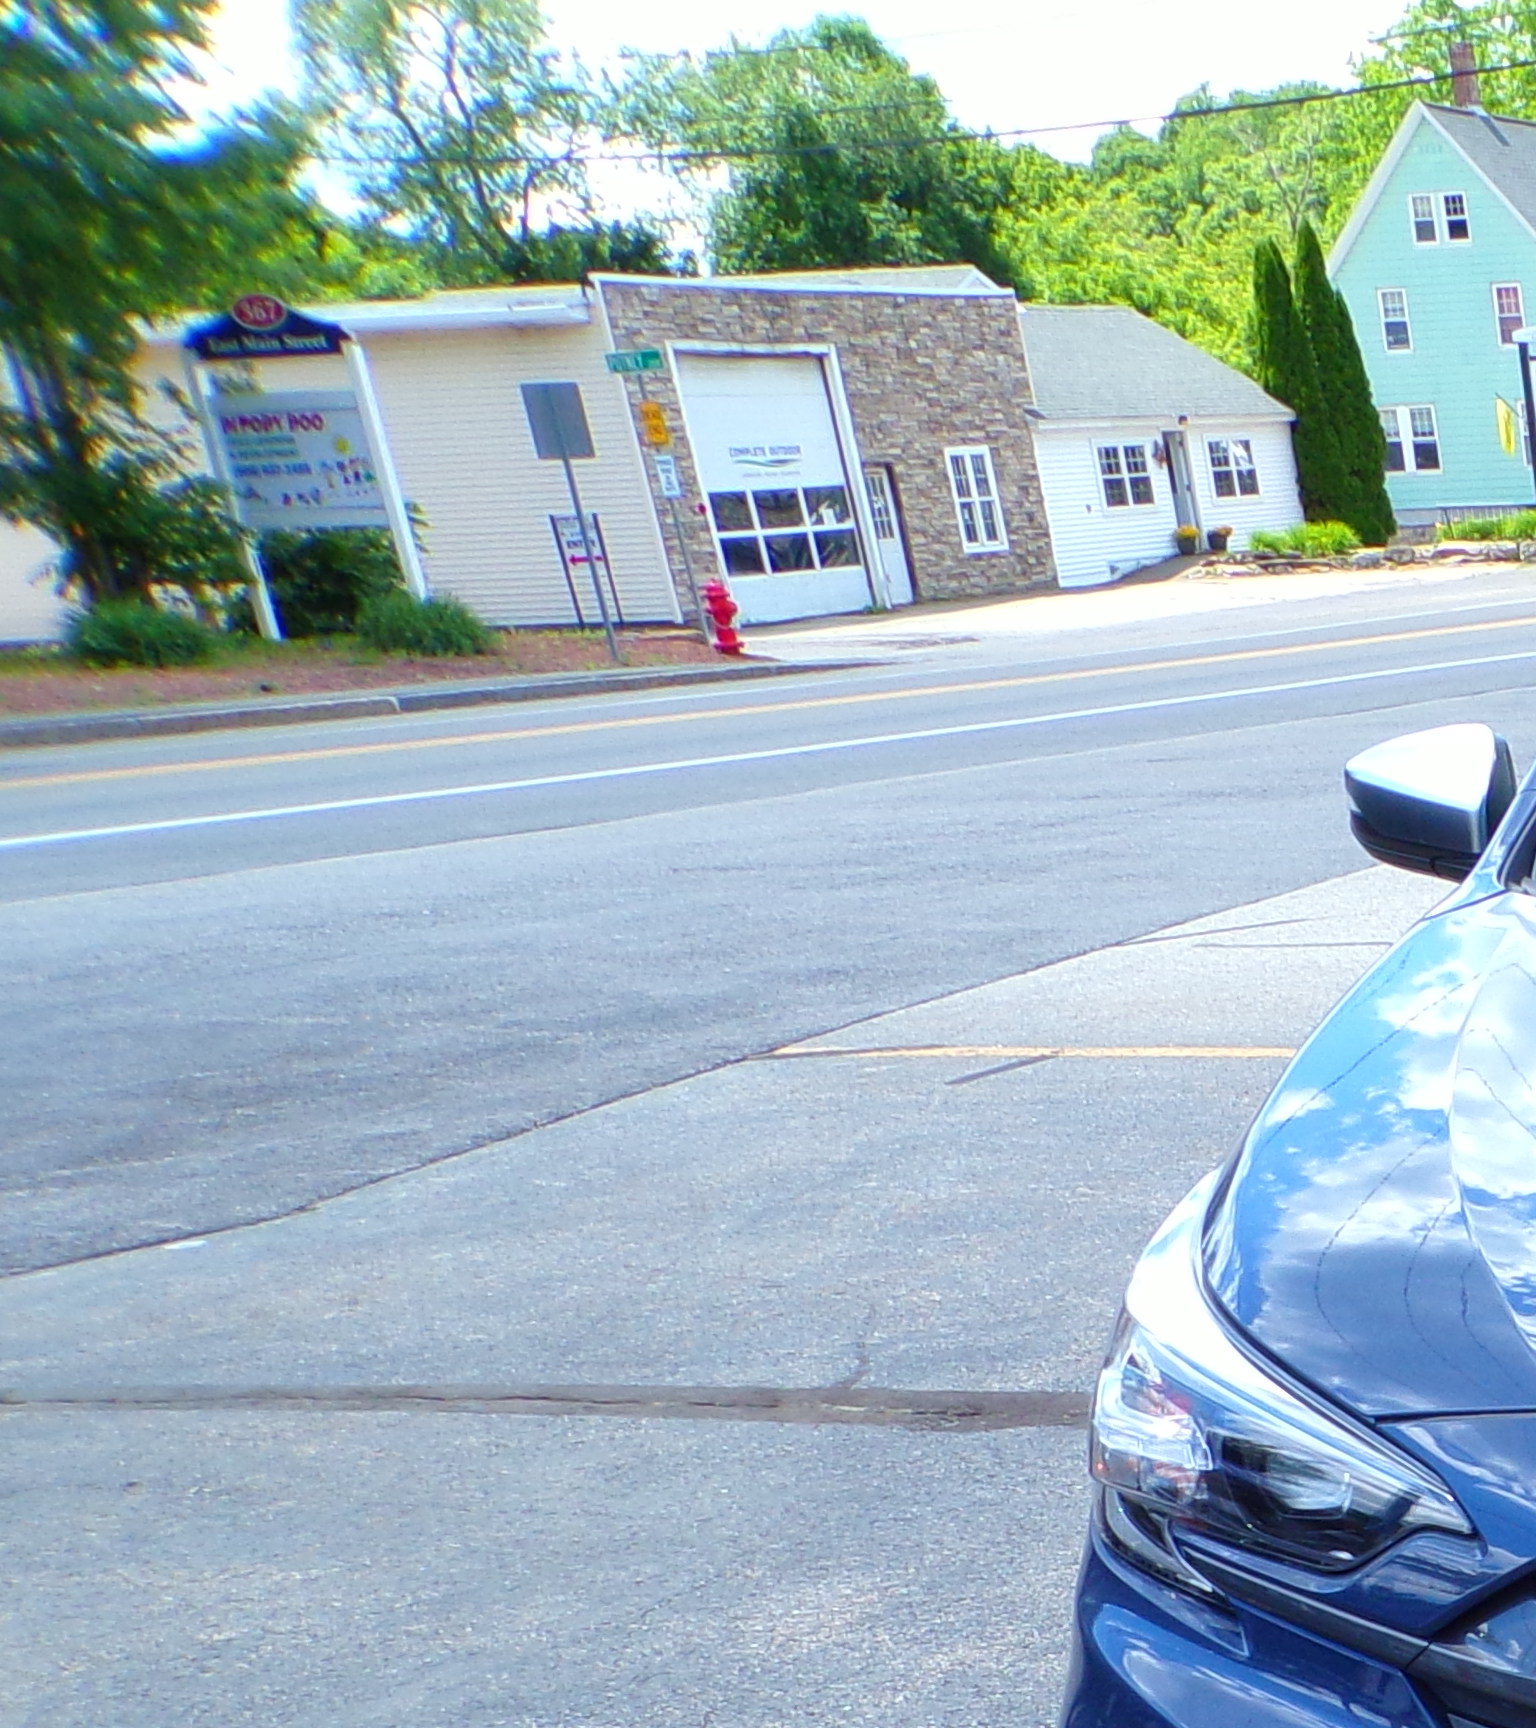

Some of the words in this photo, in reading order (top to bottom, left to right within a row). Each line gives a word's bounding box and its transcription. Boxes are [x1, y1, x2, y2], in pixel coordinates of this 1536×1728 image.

[241, 335, 281, 350] Main
[282, 333, 328, 349] Street
[729, 446, 766, 458] COMPLETE
[768, 445, 802, 456] OUTDOOR
